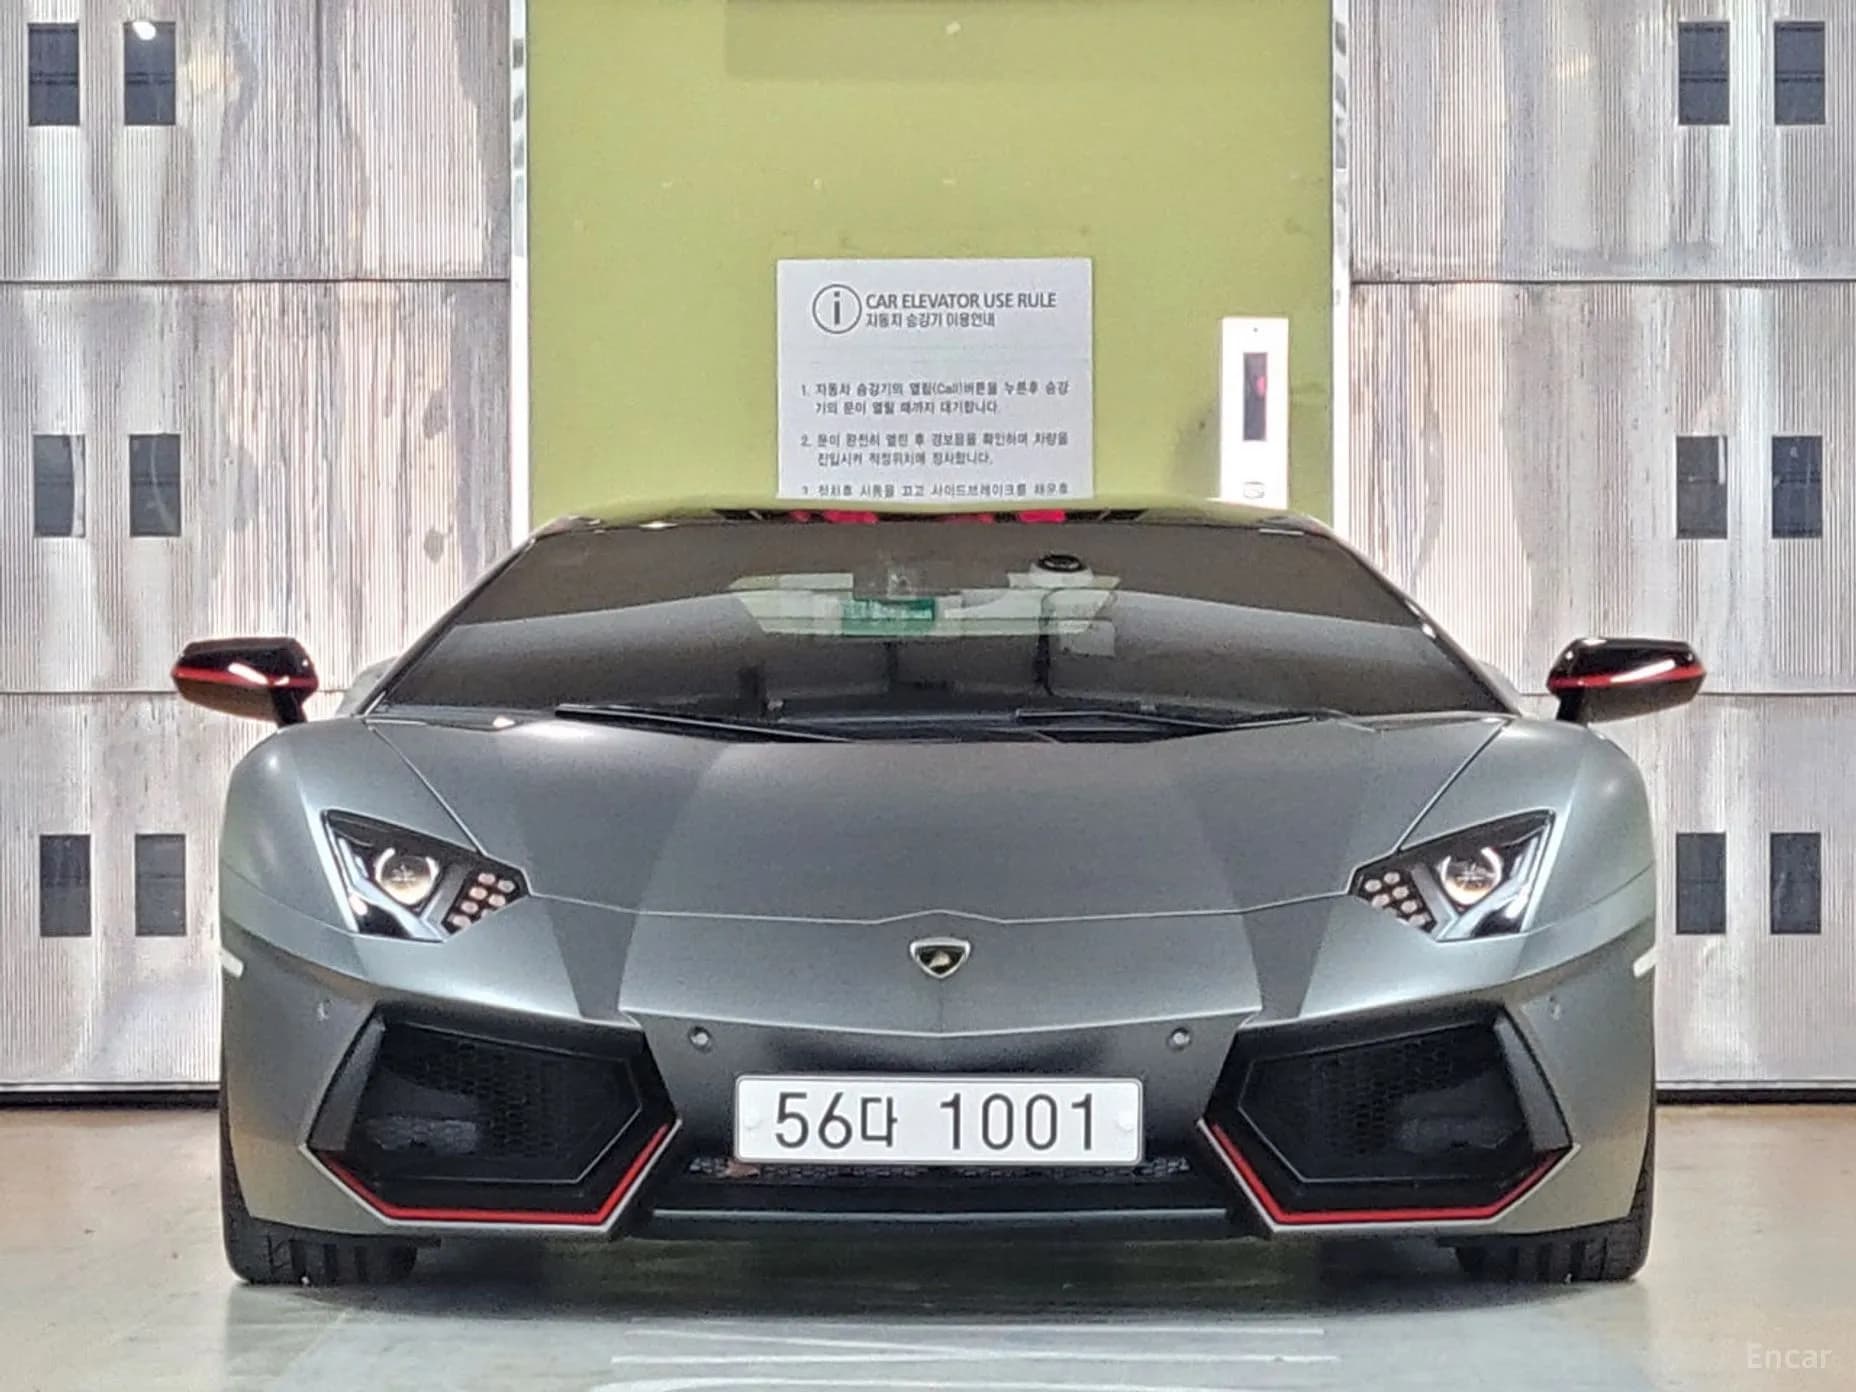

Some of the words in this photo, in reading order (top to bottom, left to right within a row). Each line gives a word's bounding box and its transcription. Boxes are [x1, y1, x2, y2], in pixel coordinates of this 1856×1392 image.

[866, 293, 898, 309] CAR
[902, 293, 980, 309] ELEVATOR
[983, 292, 1013, 308] USE
[1017, 292, 1056, 308] RULE
[866, 312, 902, 328] 자동차
[906, 312, 942, 328] 승강기
[946, 312, 995, 327] 이용안내
[775, 1091, 898, 1150] 56다
[940, 1092, 1093, 1151] 1001
